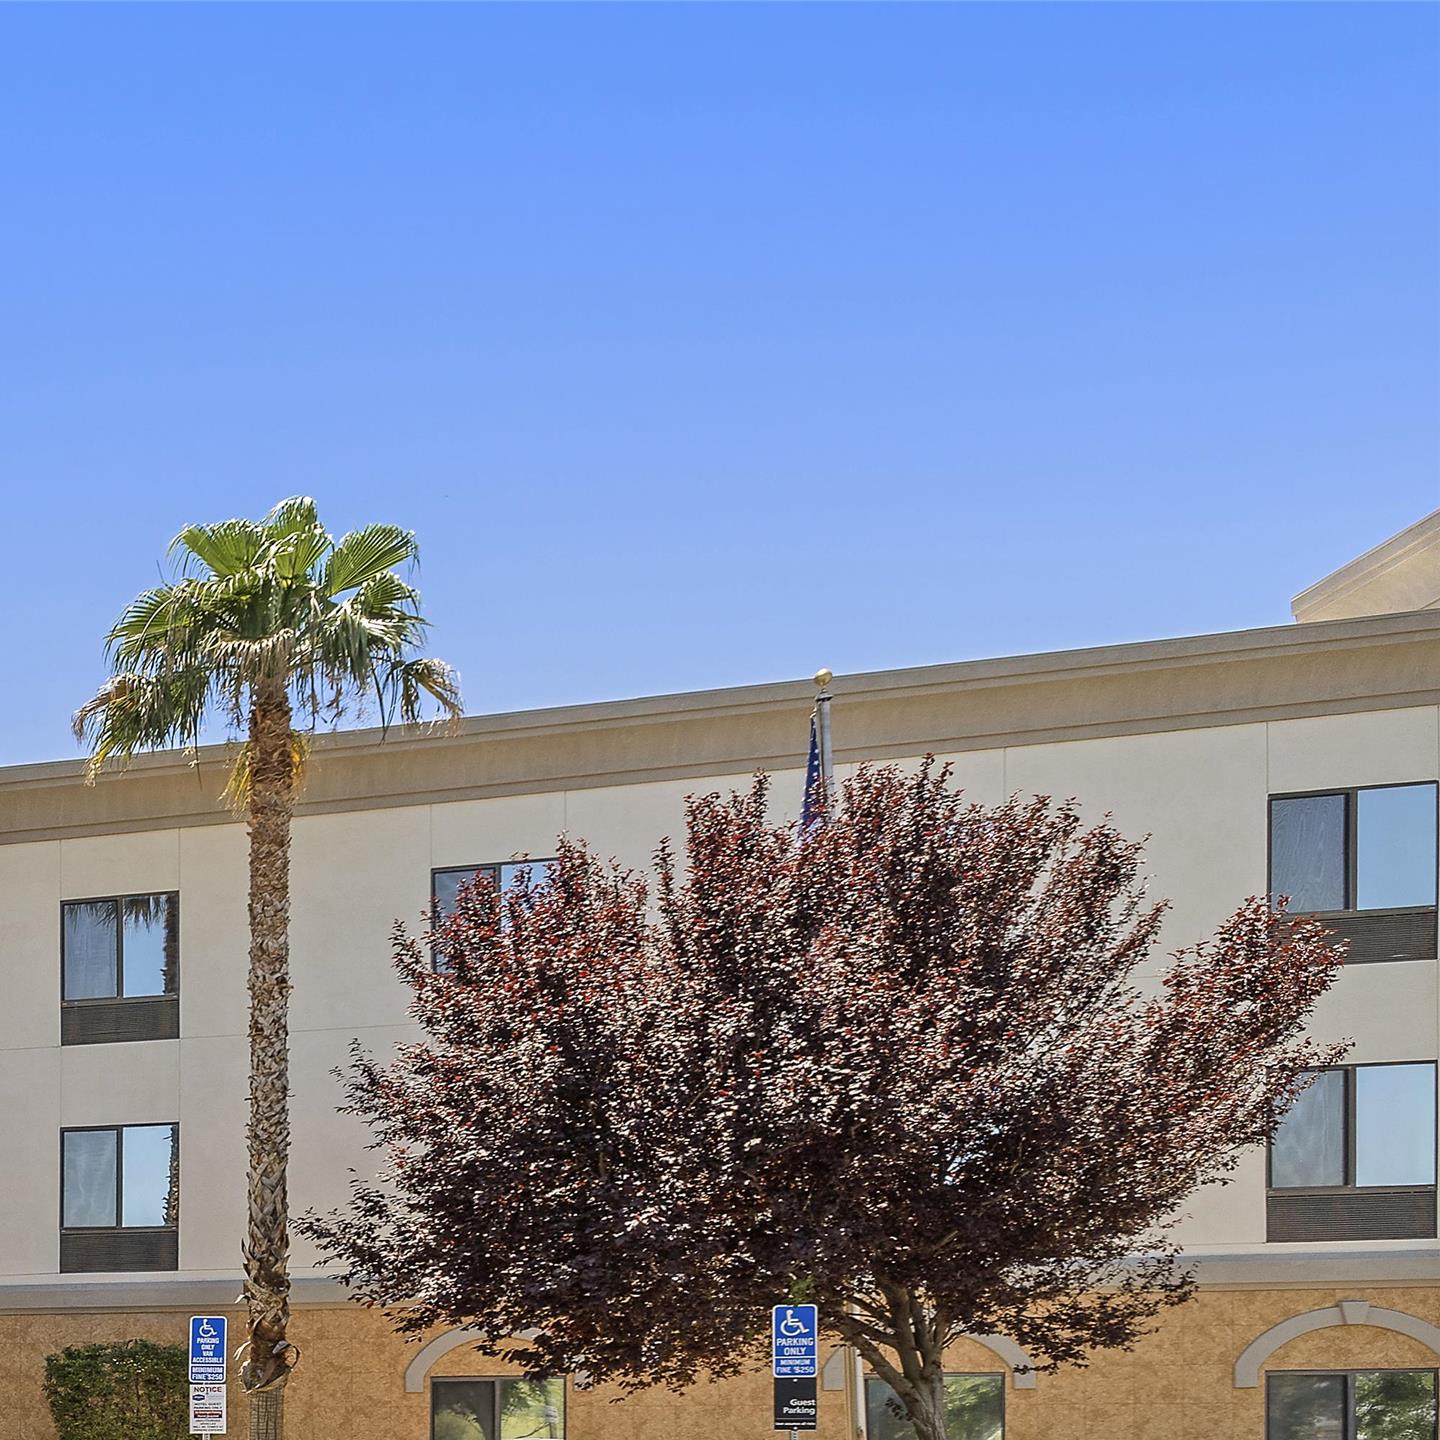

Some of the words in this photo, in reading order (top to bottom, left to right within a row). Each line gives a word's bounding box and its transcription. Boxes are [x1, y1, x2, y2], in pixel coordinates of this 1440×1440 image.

[776, 1338, 814, 1346] PARKING
[783, 1346, 807, 1355] ONLY
[776, 1366, 792, 1374] FINE
[789, 1398, 816, 1406] Guest
[783, 1406, 816, 1416] Parking
